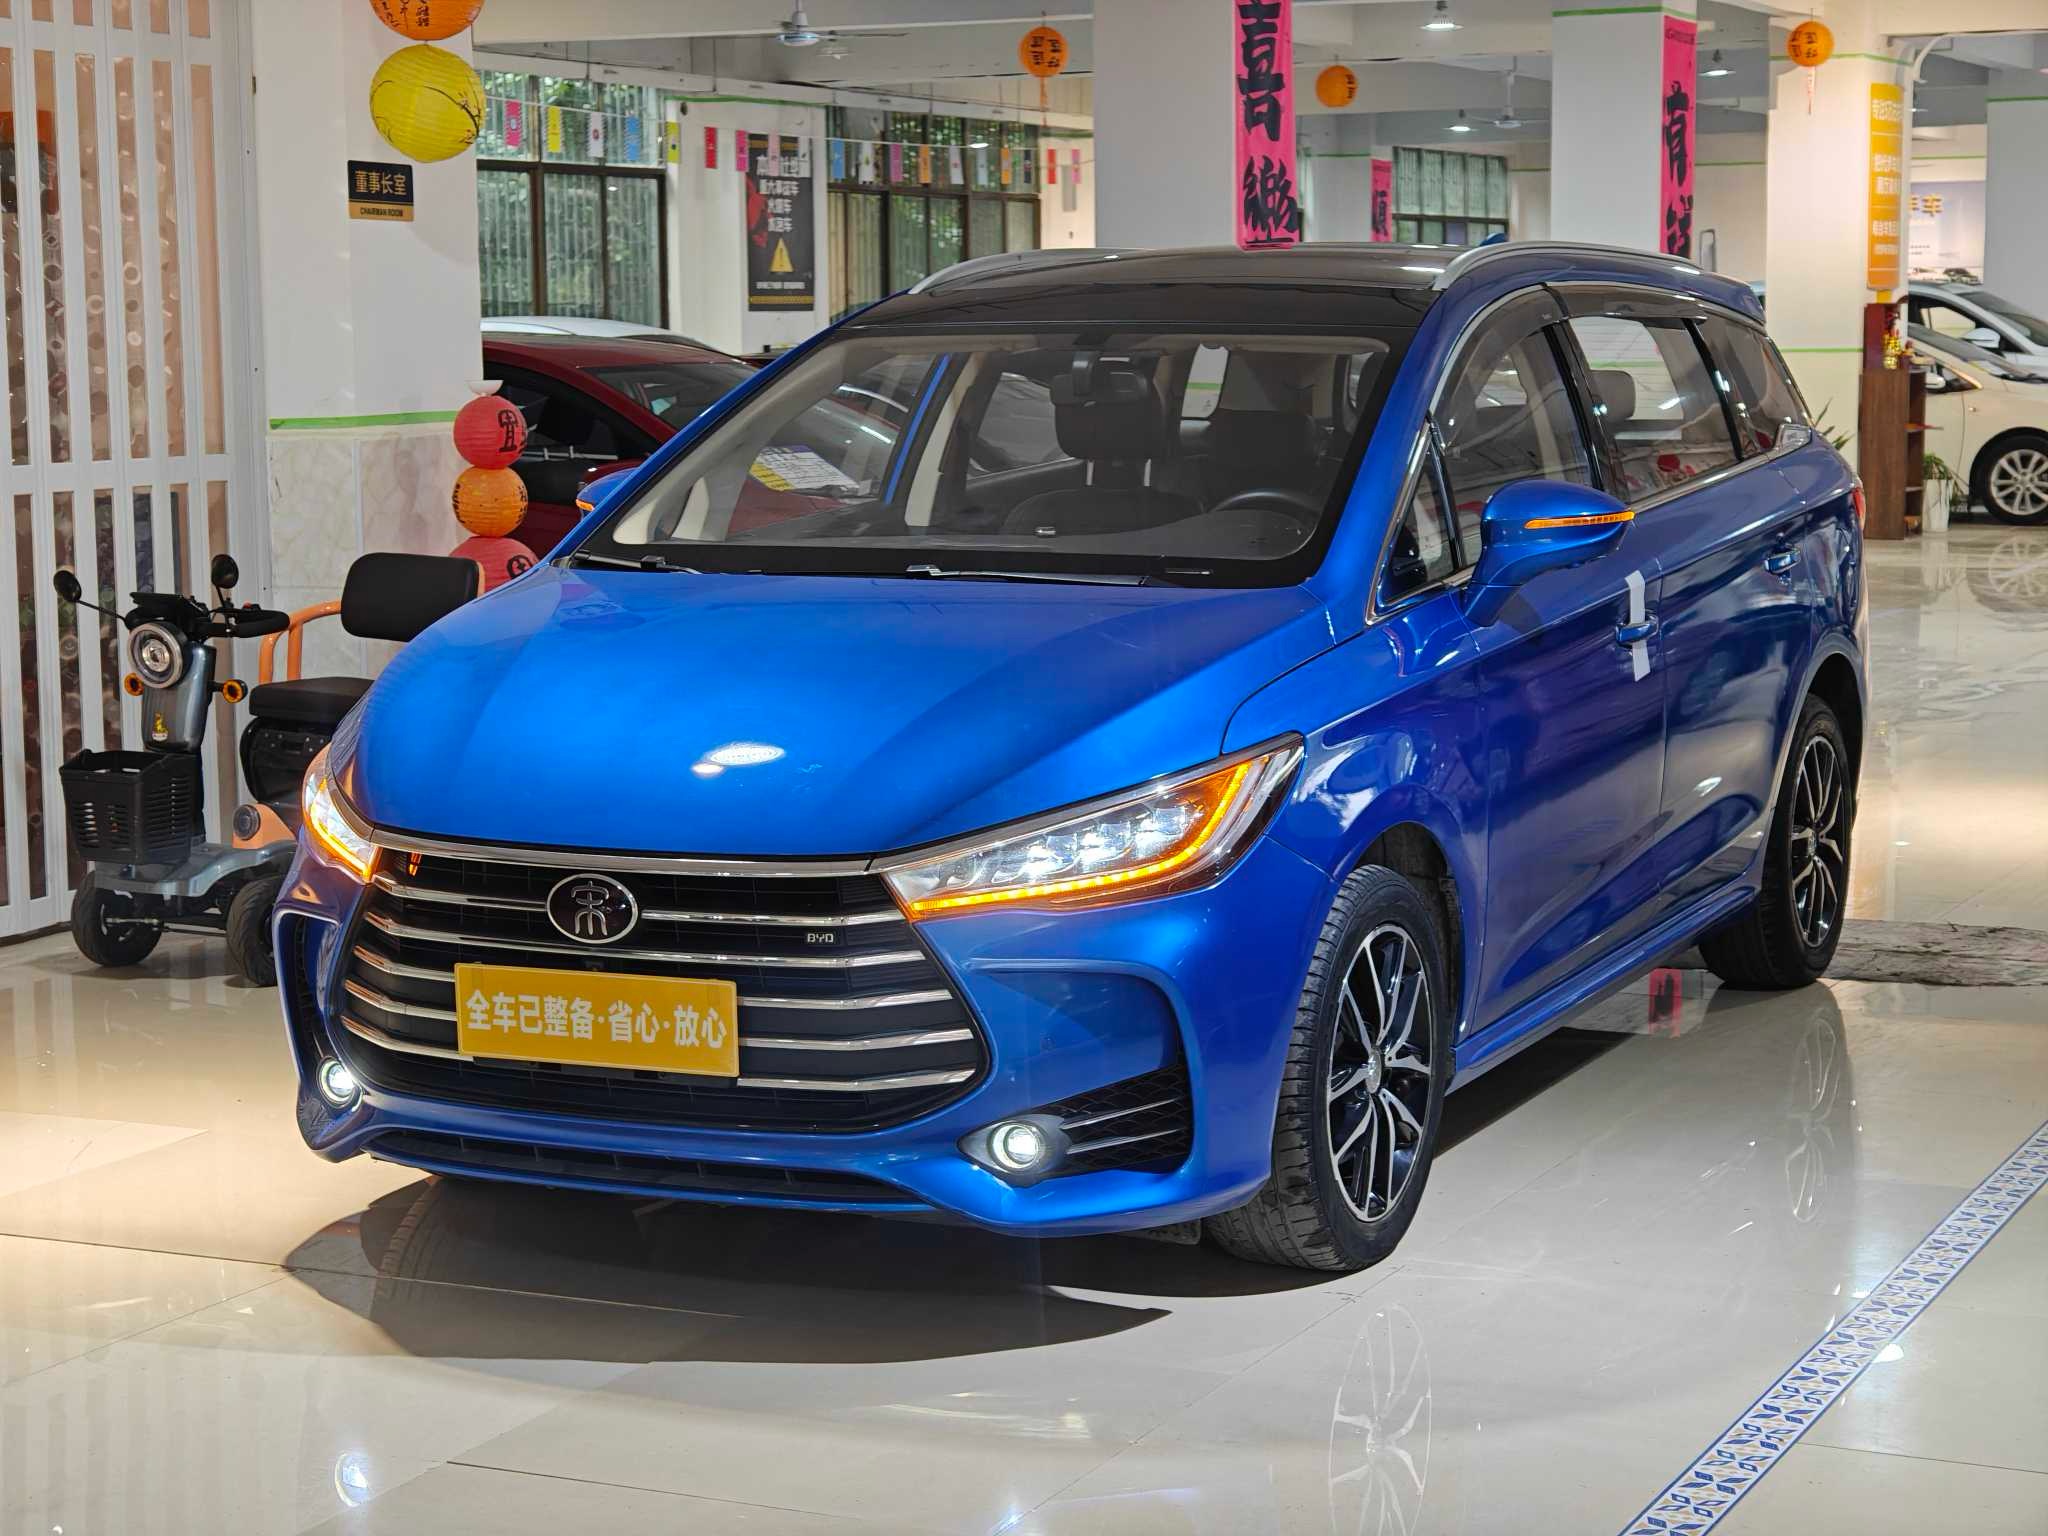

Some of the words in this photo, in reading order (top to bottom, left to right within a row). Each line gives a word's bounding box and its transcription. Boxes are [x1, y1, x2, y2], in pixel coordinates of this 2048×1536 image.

[355, 170, 407, 195] 董事长室
[807, 933, 834, 943] BYD
[466, 988, 728, 1049] 全车已整备·省心·放心
